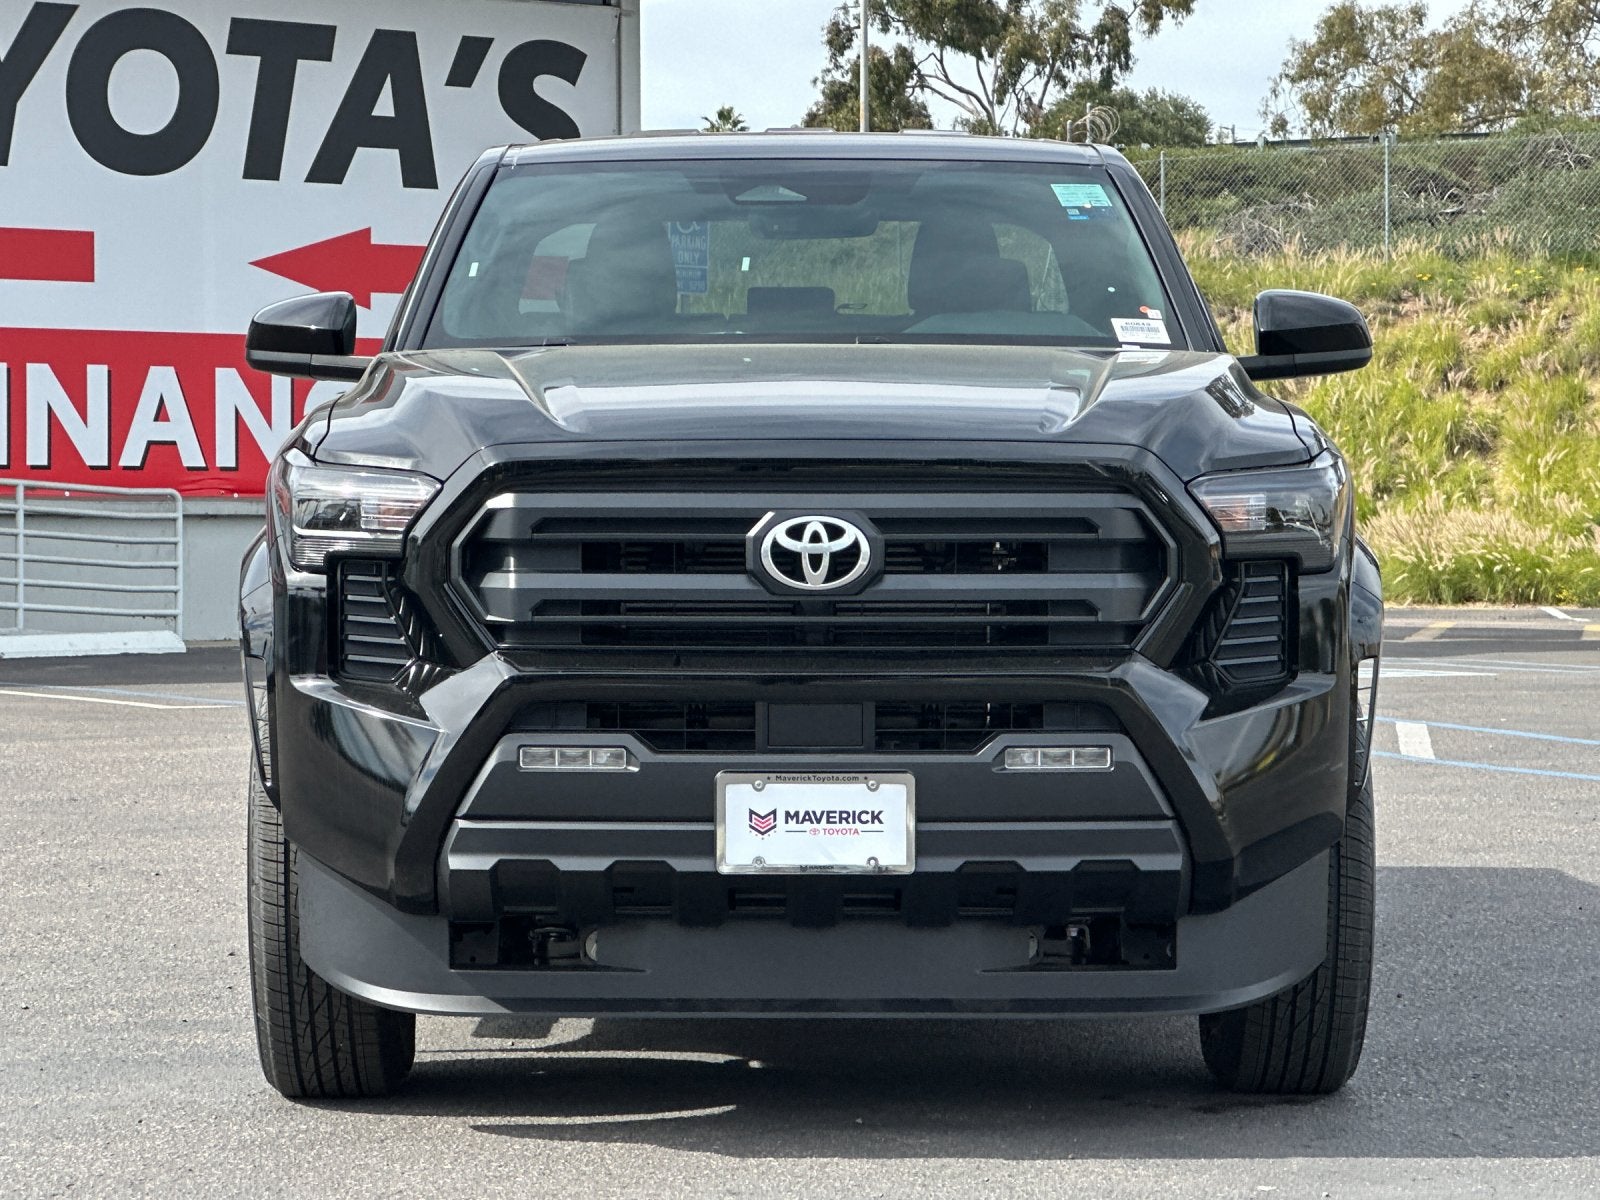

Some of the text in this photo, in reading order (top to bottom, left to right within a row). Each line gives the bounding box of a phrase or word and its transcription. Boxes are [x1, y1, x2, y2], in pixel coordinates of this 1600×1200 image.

[679, 250, 700, 265] ONLY
[775, 774, 860, 783] MaverickToyota.com
[784, 810, 884, 825] MAVERICK
[822, 827, 860, 836] TOYOTA
